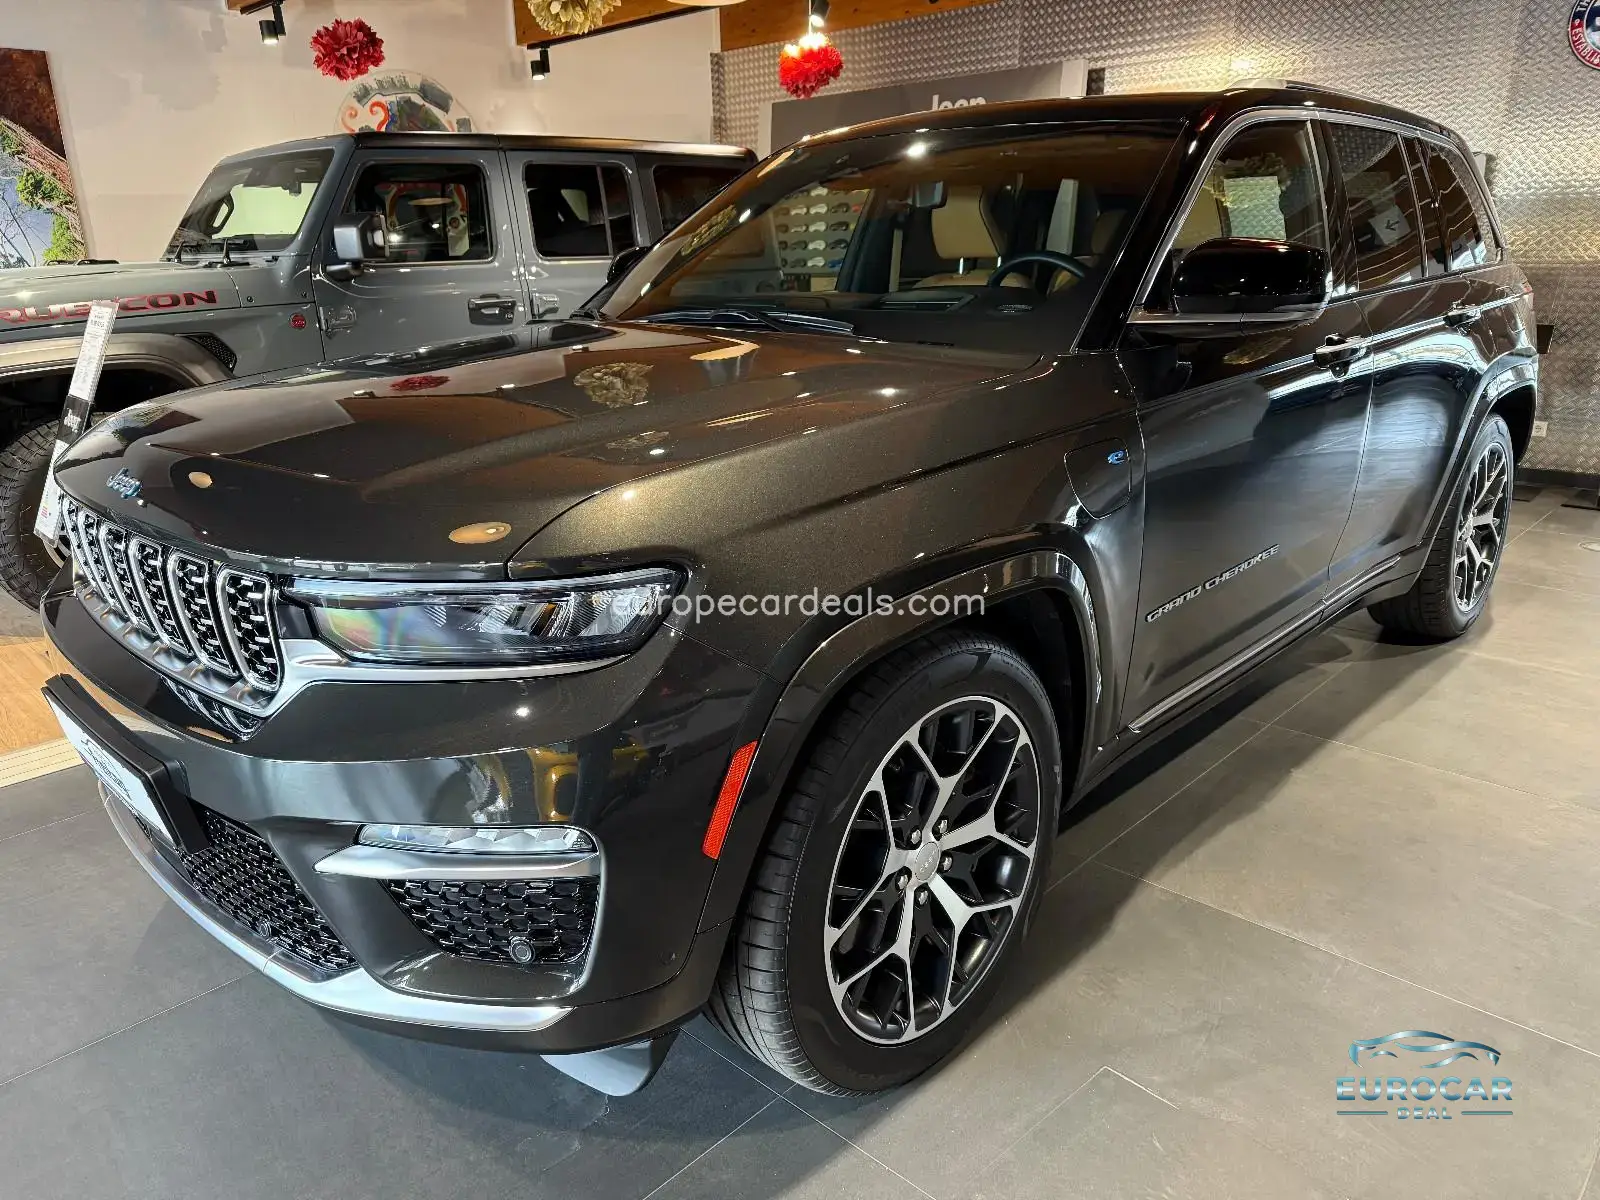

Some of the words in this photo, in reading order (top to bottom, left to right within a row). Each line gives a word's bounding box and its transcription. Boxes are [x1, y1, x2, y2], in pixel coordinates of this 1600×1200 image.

[0, 290, 216, 324] RUBCON
[106, 467, 142, 499] Jeep
[1145, 585, 1202, 623] GRAND
[1203, 543, 1280, 590] CHEROKEE
